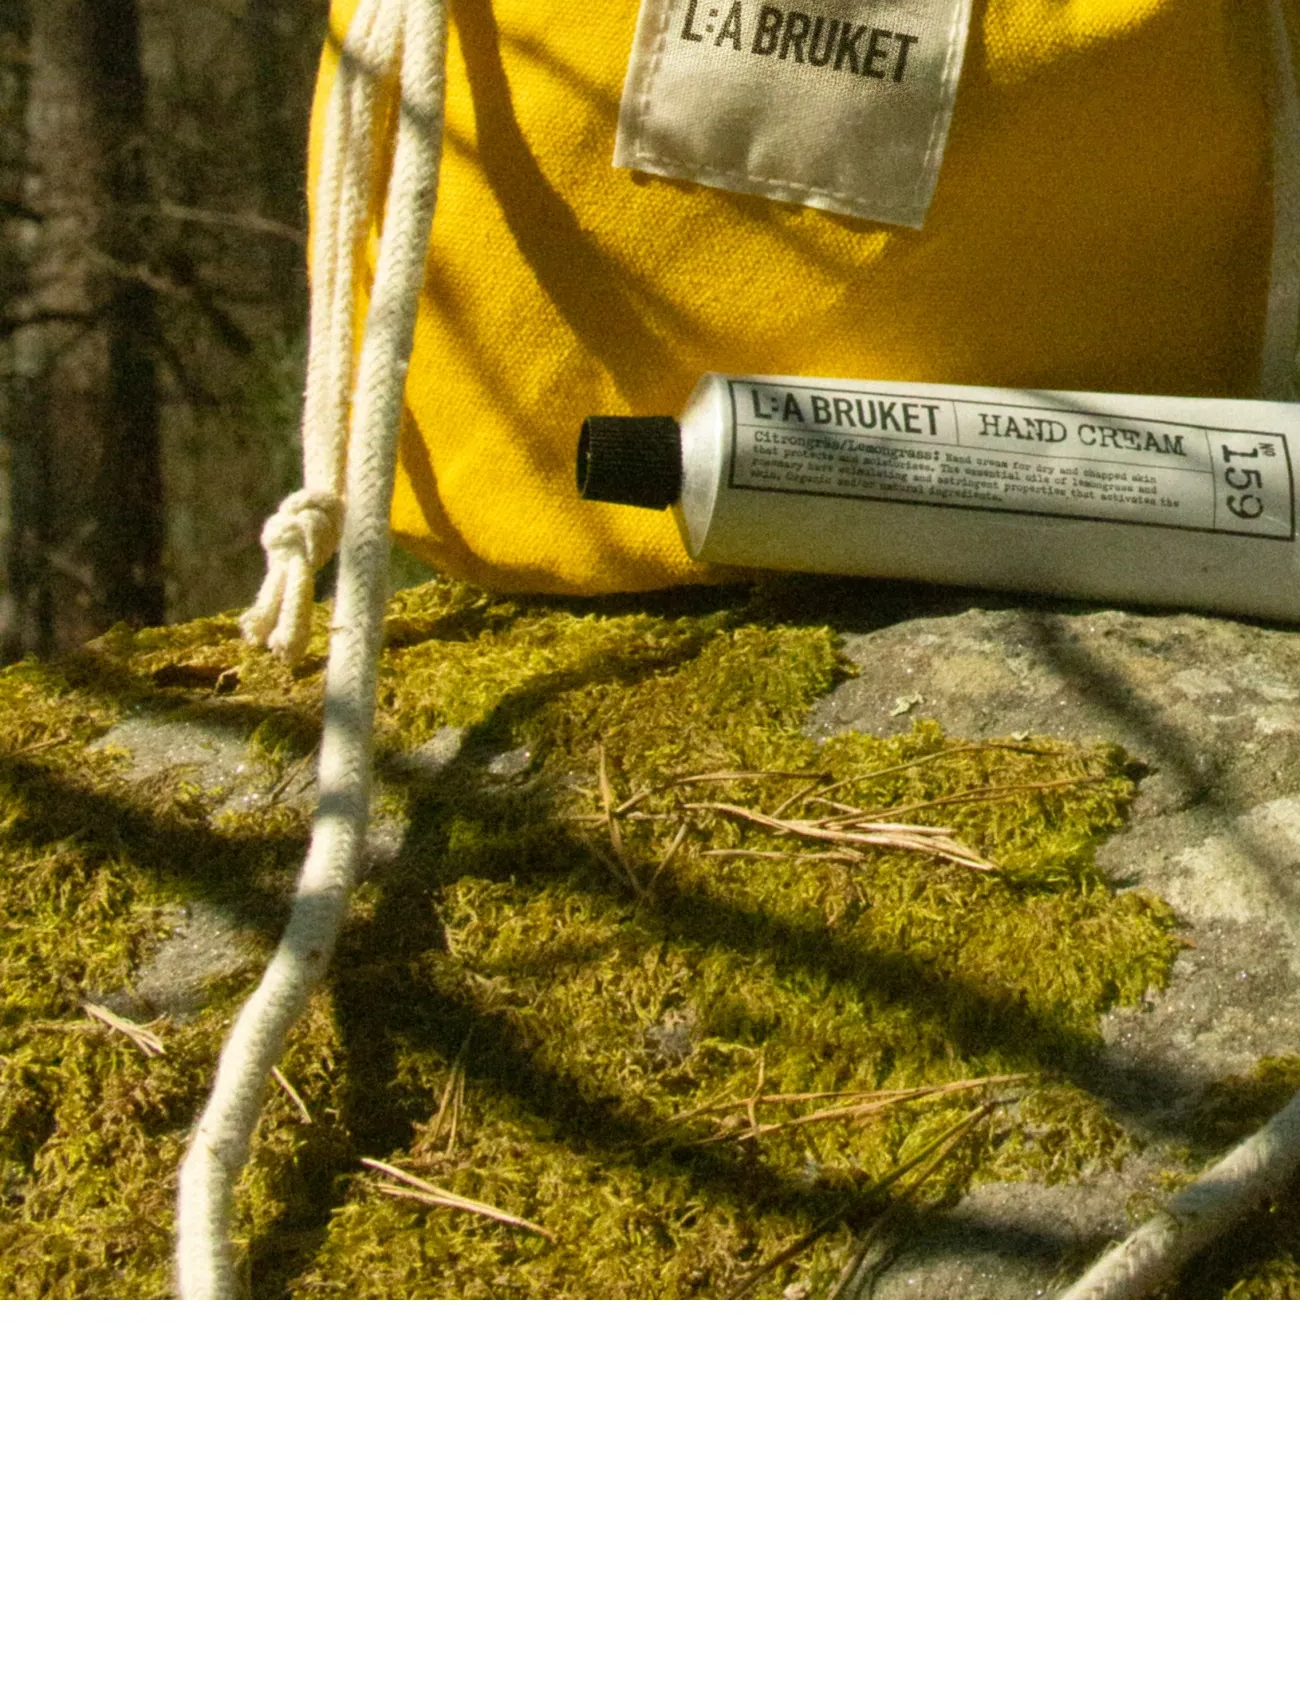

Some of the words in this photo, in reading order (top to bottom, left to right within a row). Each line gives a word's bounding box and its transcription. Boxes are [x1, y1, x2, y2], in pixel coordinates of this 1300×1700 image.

[750, 5, 919, 83] BRUKET
[751, 389, 804, 422] L:A
[811, 396, 940, 436] BRUKET
[978, 413, 1067, 443] HAND
[1077, 424, 1188, 457] CREAM
[1013, 461, 1031, 471] for
[1036, 464, 1055, 475] dry
[1059, 467, 1079, 476] and
[1083, 469, 1127, 481] chapped
[1131, 473, 1157, 484] skin
[1025, 474, 1050, 483] oils
[1054, 476, 1068, 485] of
[1071, 488, 1095, 499] that
[1222, 444, 1264, 520] 159
